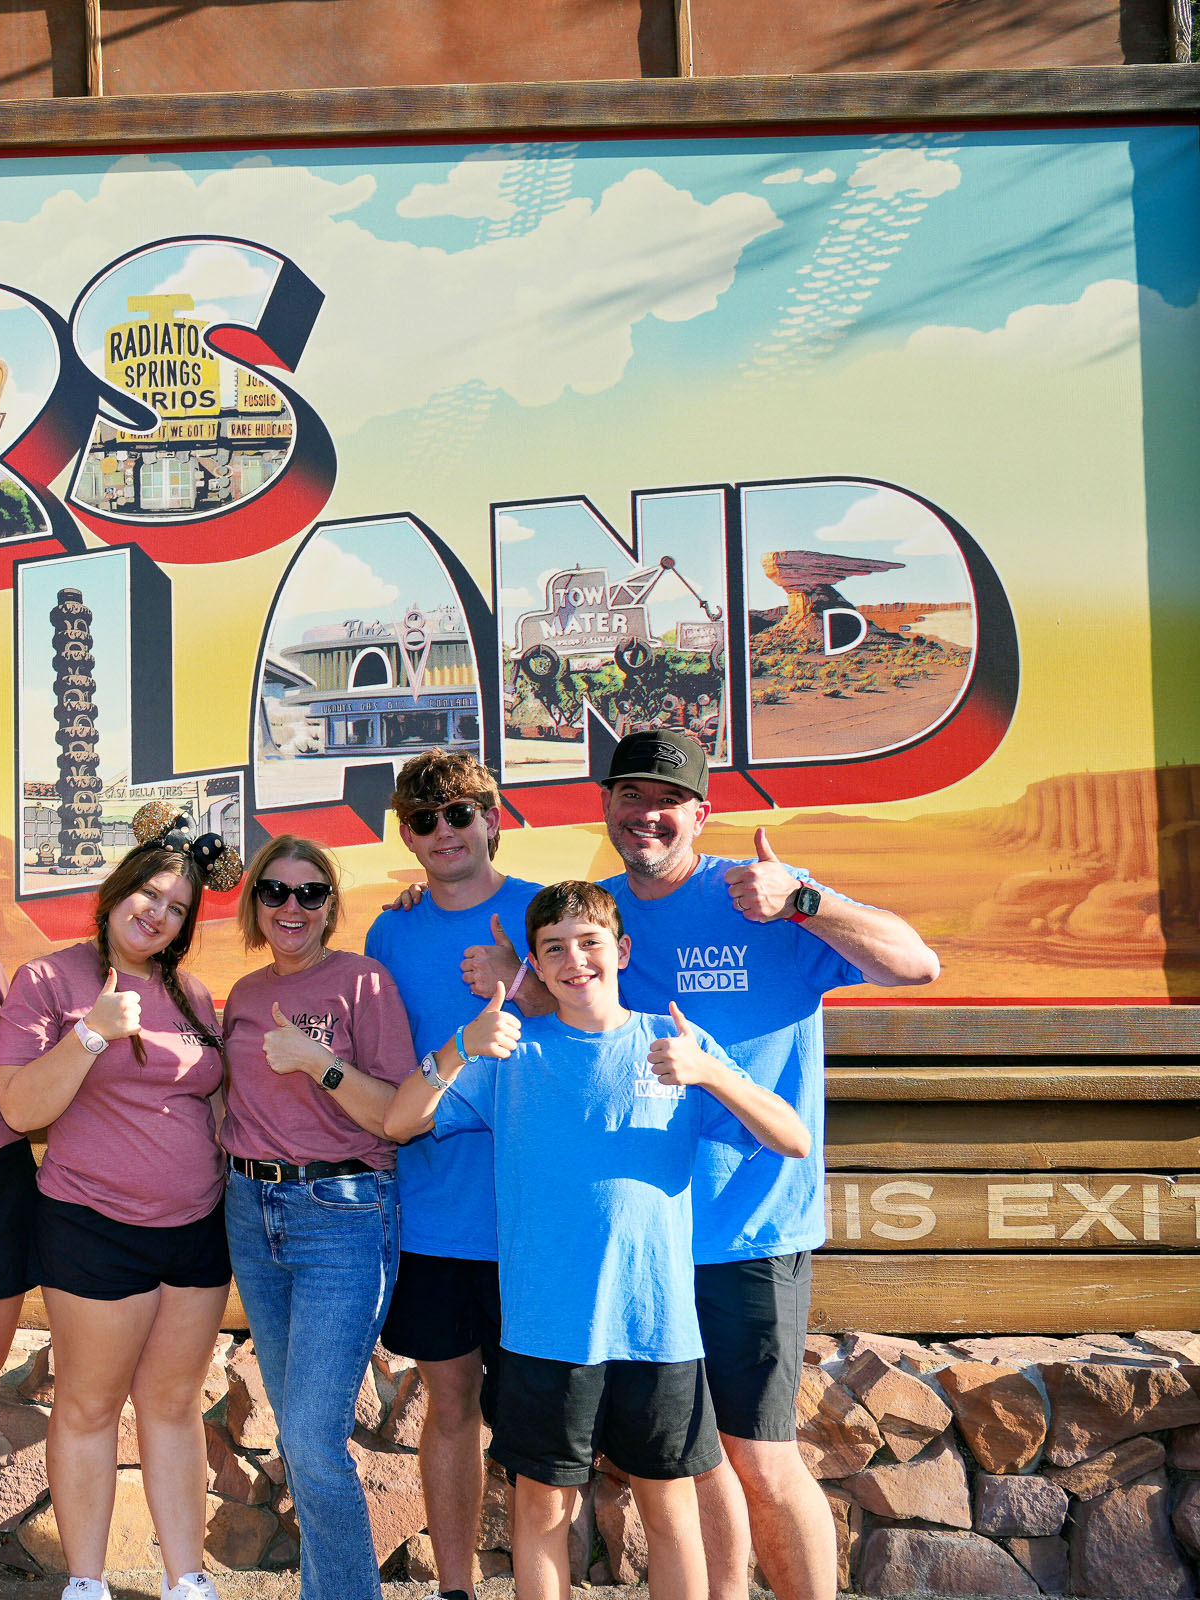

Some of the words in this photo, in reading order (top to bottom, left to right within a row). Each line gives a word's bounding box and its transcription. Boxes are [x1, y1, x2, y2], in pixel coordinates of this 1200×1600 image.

[125, 359, 201, 388] SPRINGS
[131, 389, 216, 411] RIOS
[243, 393, 276, 408] FOSSILS
[170, 423, 183, 438] WE
[187, 424, 204, 438] GOT
[208, 423, 216, 437] IT
[231, 423, 252, 437] RARE
[555, 586, 606, 608] TOW
[539, 612, 629, 640] MATER
[13, 478, 1021, 942] LAND
[129, 786, 156, 798] DELLA
[676, 945, 748, 969] VACAY
[679, 972, 747, 991] MODE
[172, 1021, 218, 1034] VAY
[292, 1013, 340, 1030] VACAY
[181, 1033, 225, 1048] MOE
